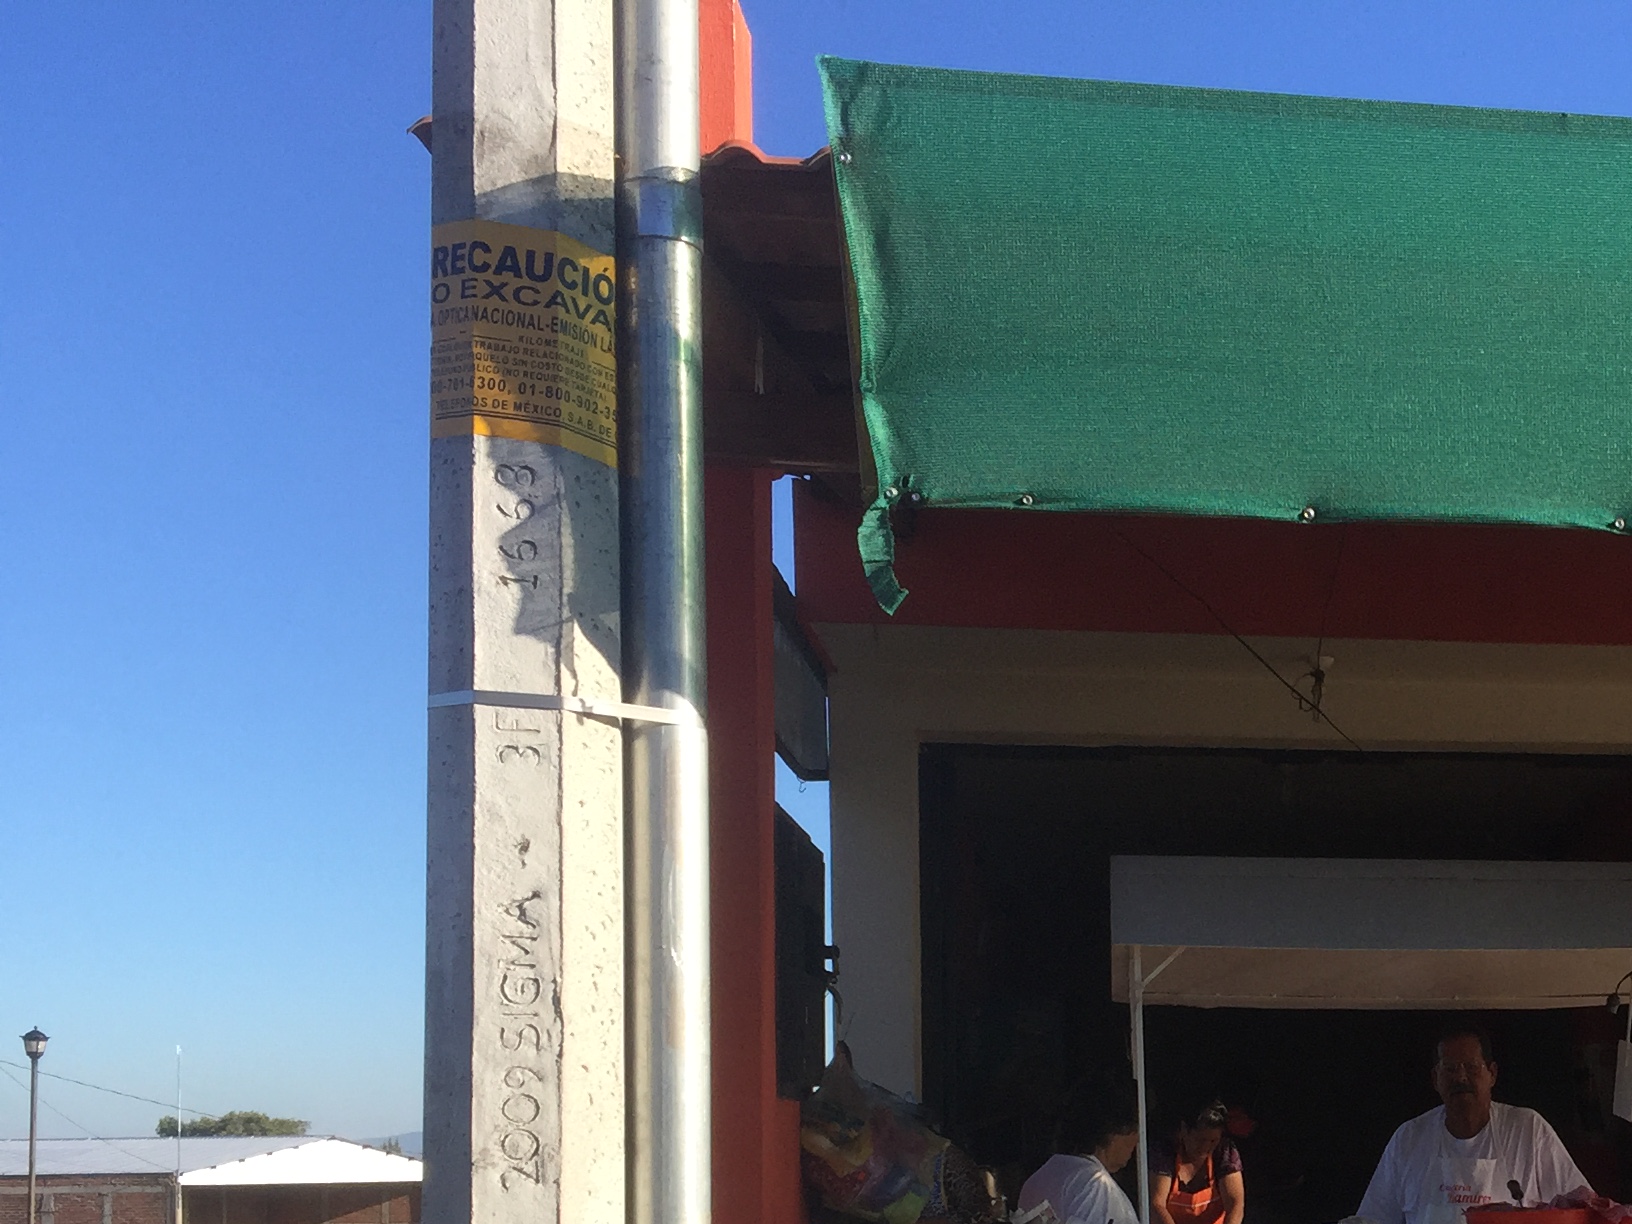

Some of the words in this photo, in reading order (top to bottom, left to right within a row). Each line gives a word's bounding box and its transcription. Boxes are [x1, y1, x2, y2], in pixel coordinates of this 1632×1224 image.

[474, 340, 520, 355] TRABAJO
[492, 399, 508, 410] DE
[498, 889, 542, 1052] SIGMA
[499, 1065, 543, 1193] 2009
